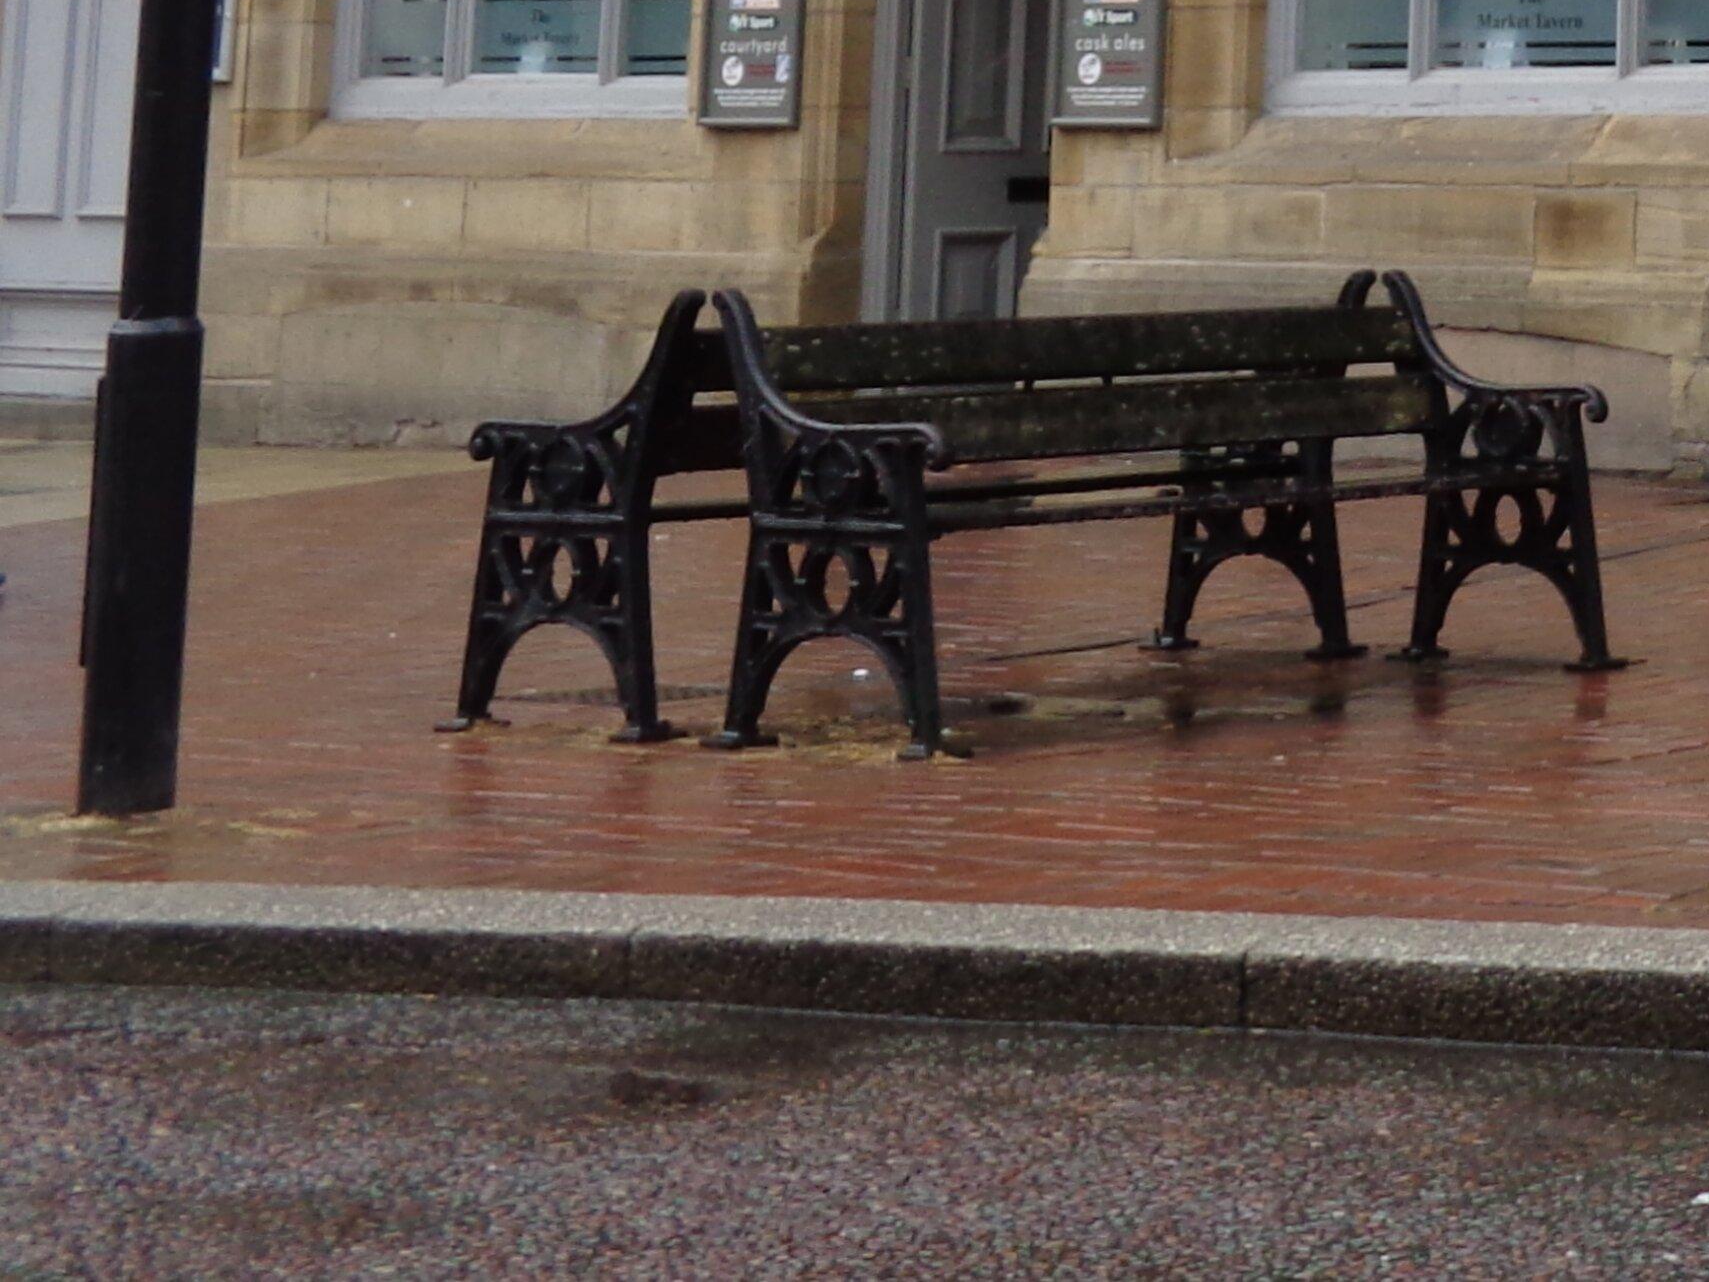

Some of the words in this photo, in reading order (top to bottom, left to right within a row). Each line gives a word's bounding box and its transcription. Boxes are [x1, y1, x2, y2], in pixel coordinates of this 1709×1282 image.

[1477, 13, 1530, 29] Market
[719, 36, 788, 56] courtyard
[1074, 34, 1110, 53] cask
[1113, 33, 1146, 53] ales
